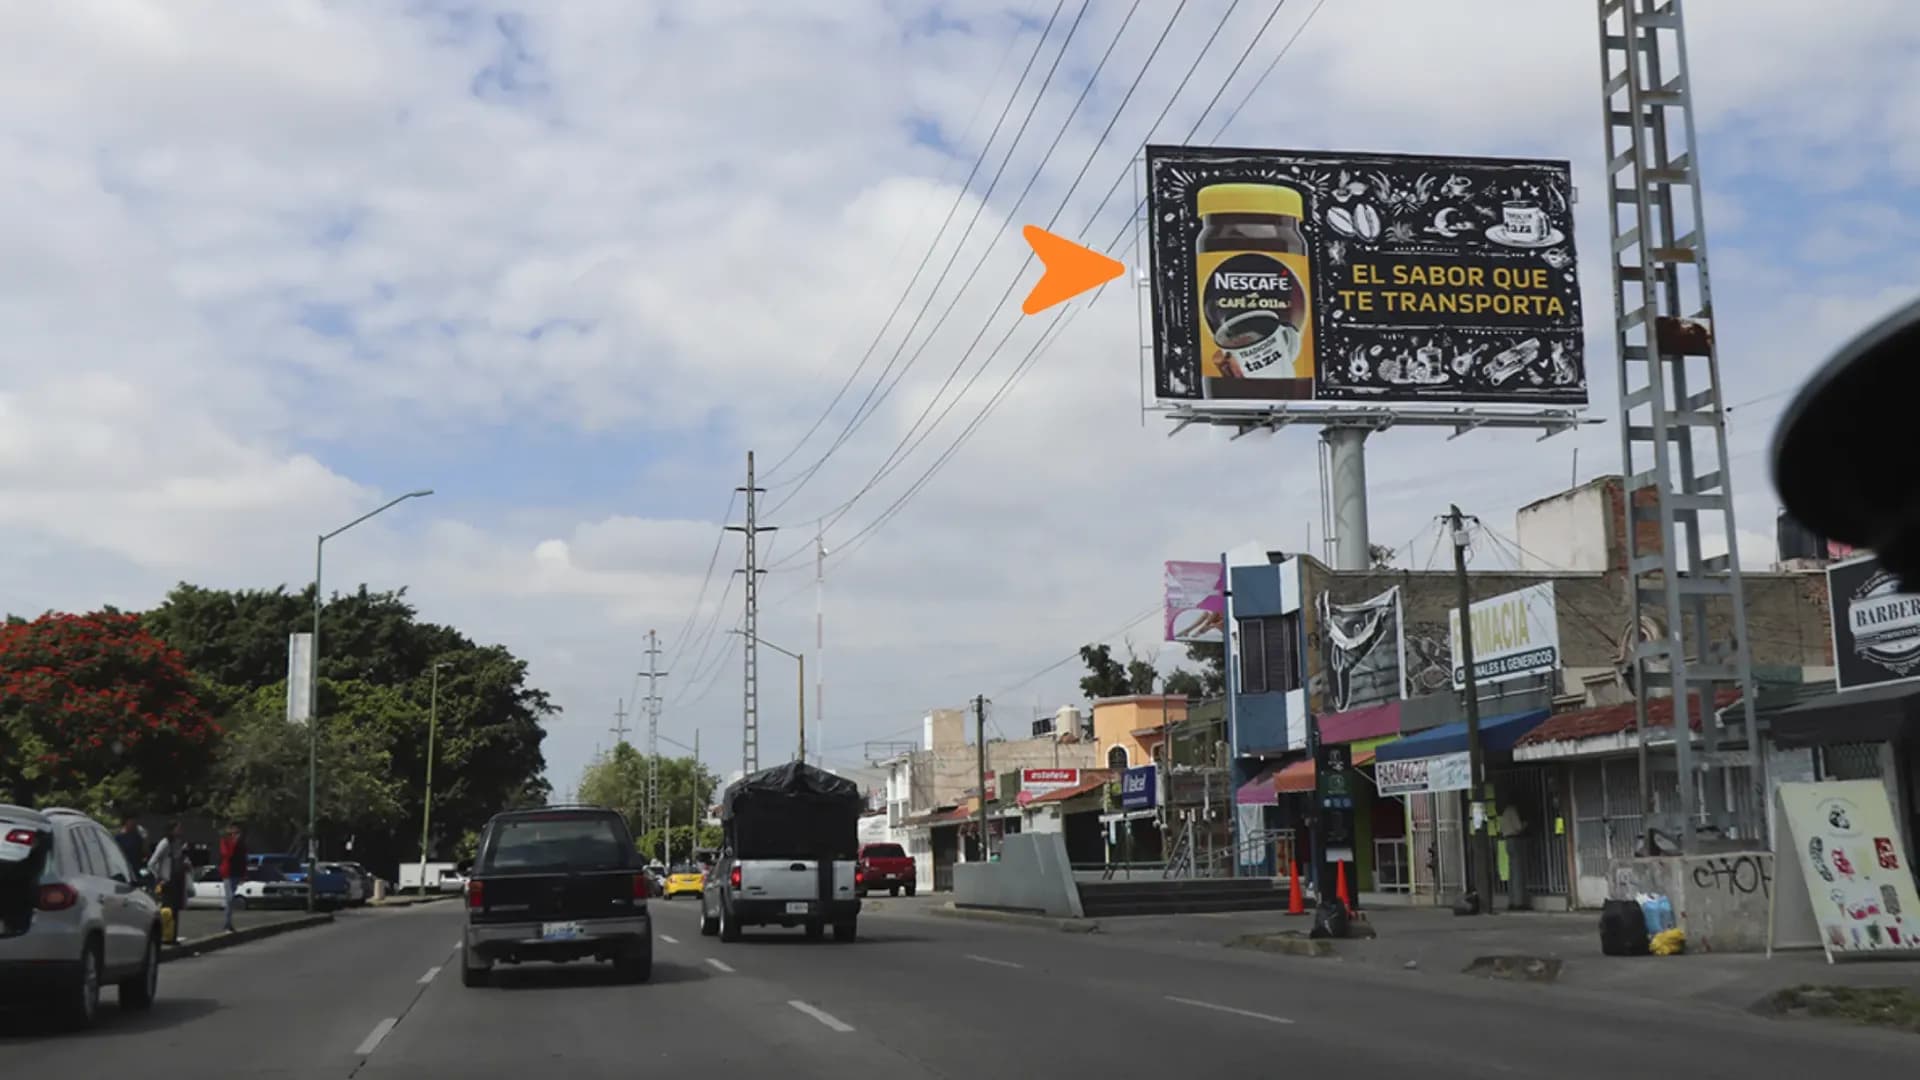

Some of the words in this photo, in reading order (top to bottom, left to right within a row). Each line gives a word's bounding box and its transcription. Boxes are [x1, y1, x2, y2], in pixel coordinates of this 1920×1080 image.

[1214, 269, 1289, 291] NESCAFÉ
[1352, 264, 1385, 284] EL
[1393, 265, 1484, 287] SABOR
[1493, 268, 1548, 290] QUE
[1338, 290, 1373, 311] TE
[1381, 291, 1564, 316] TRANSPORTA
[1245, 351, 1282, 372] taza
[1453, 598, 1531, 663] FRMACIA
[1507, 649, 1552, 671] GENERICOS
